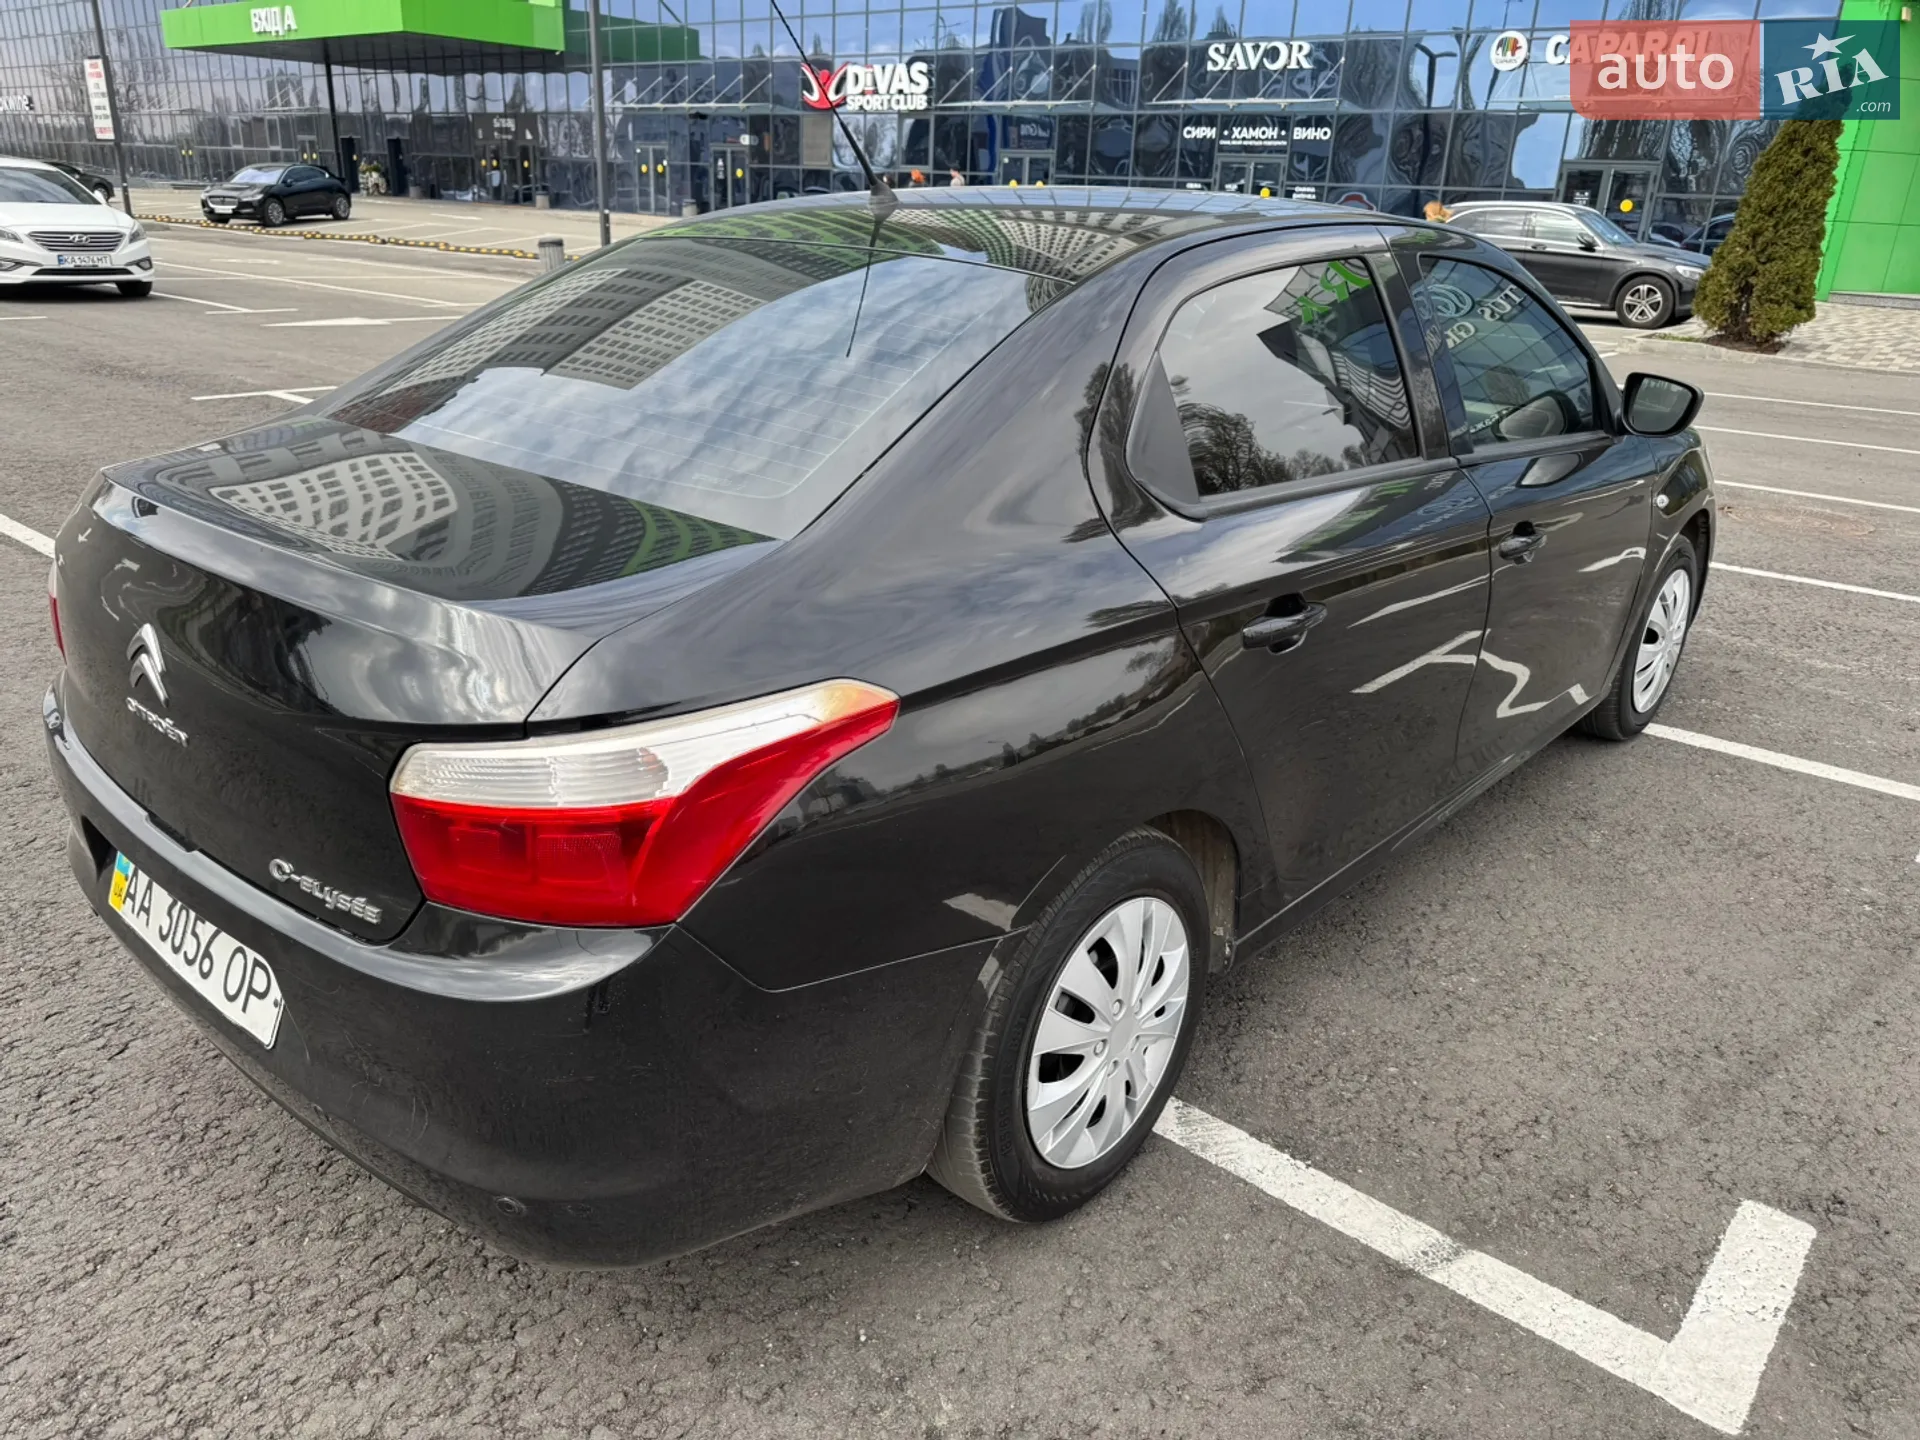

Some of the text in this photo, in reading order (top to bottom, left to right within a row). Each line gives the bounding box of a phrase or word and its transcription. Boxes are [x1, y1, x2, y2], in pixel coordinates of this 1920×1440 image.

[250, 7, 283, 36] ВХІД
[1207, 41, 1315, 71] SAVOR
[846, 94, 928, 111] SPORT CLUB
[1183, 126, 1331, 140] СИРИ ХАМОН ВИНО
[122, 866, 272, 1014] AA 3056 OP
